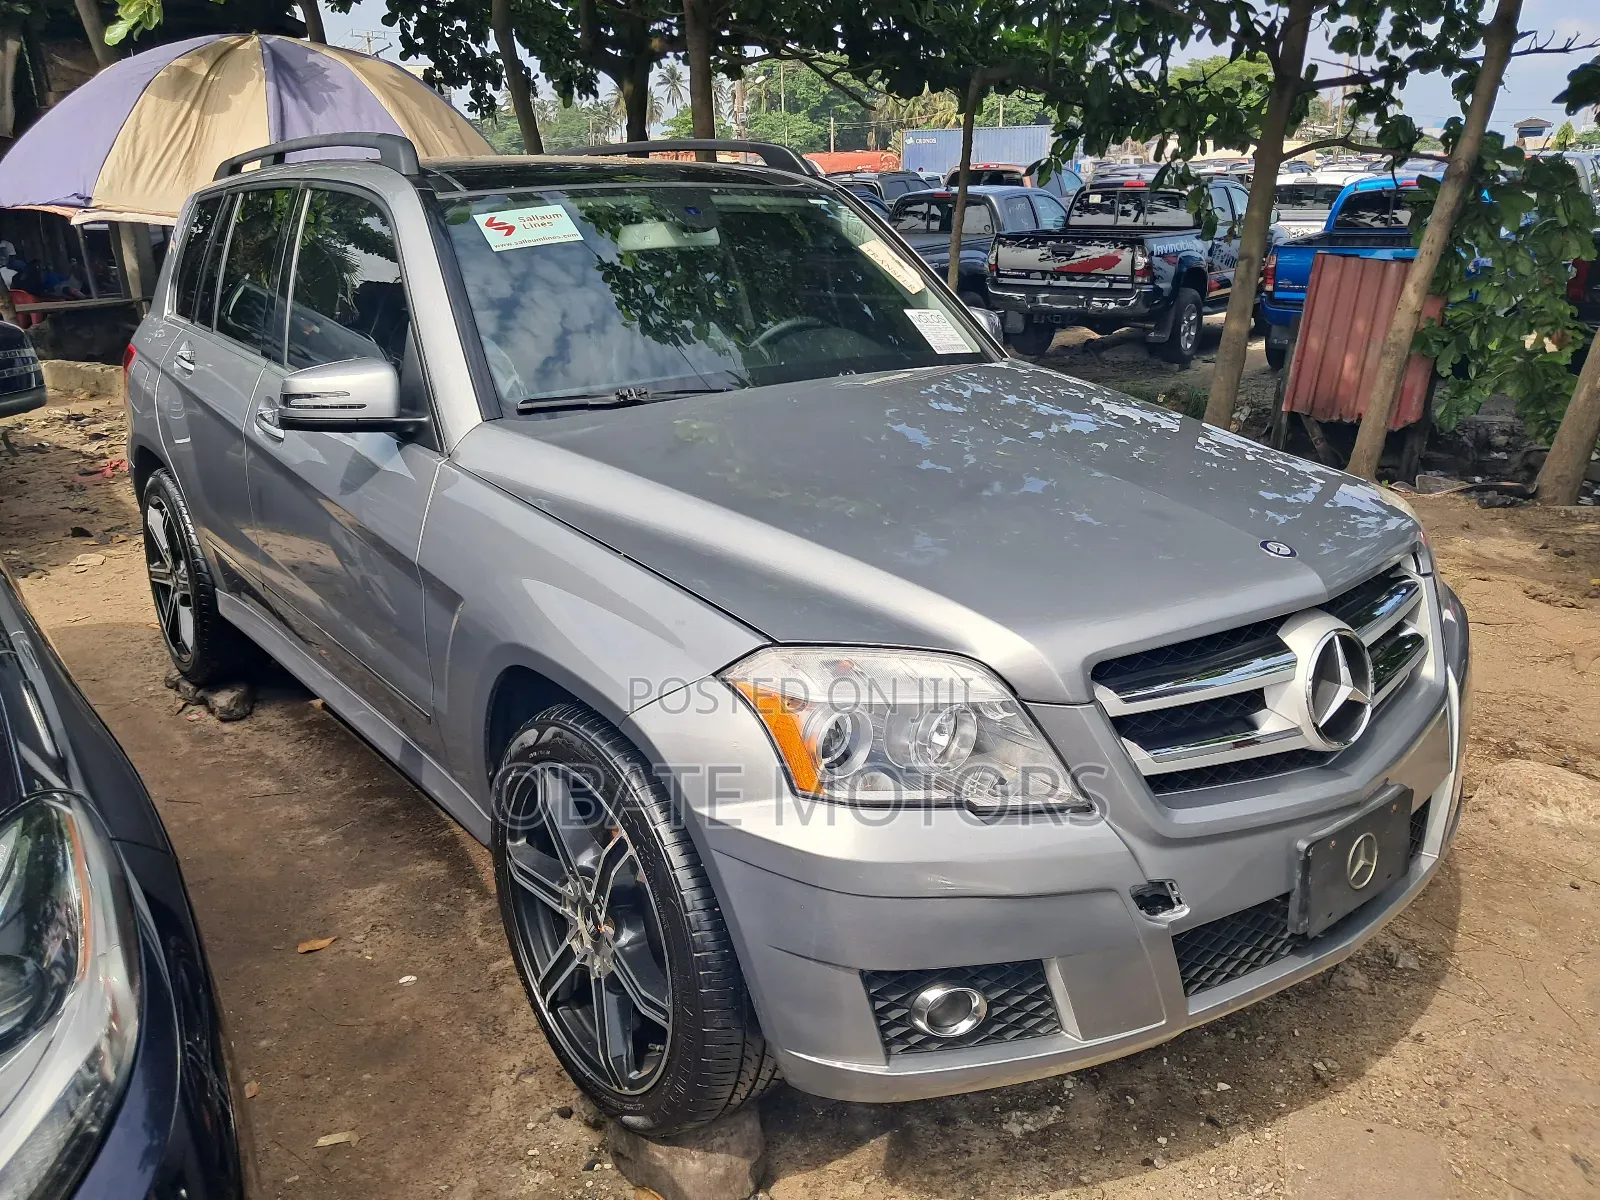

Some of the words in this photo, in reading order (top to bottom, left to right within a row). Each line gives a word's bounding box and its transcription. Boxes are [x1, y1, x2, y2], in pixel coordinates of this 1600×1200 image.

[517, 213, 563, 223] Sallaum
[522, 220, 554, 230] Lines
[493, 232, 579, 249] www.sallaumlines.com
[1152, 239, 1195, 256] Invincible
[866, 246, 916, 292] TRANSFER
